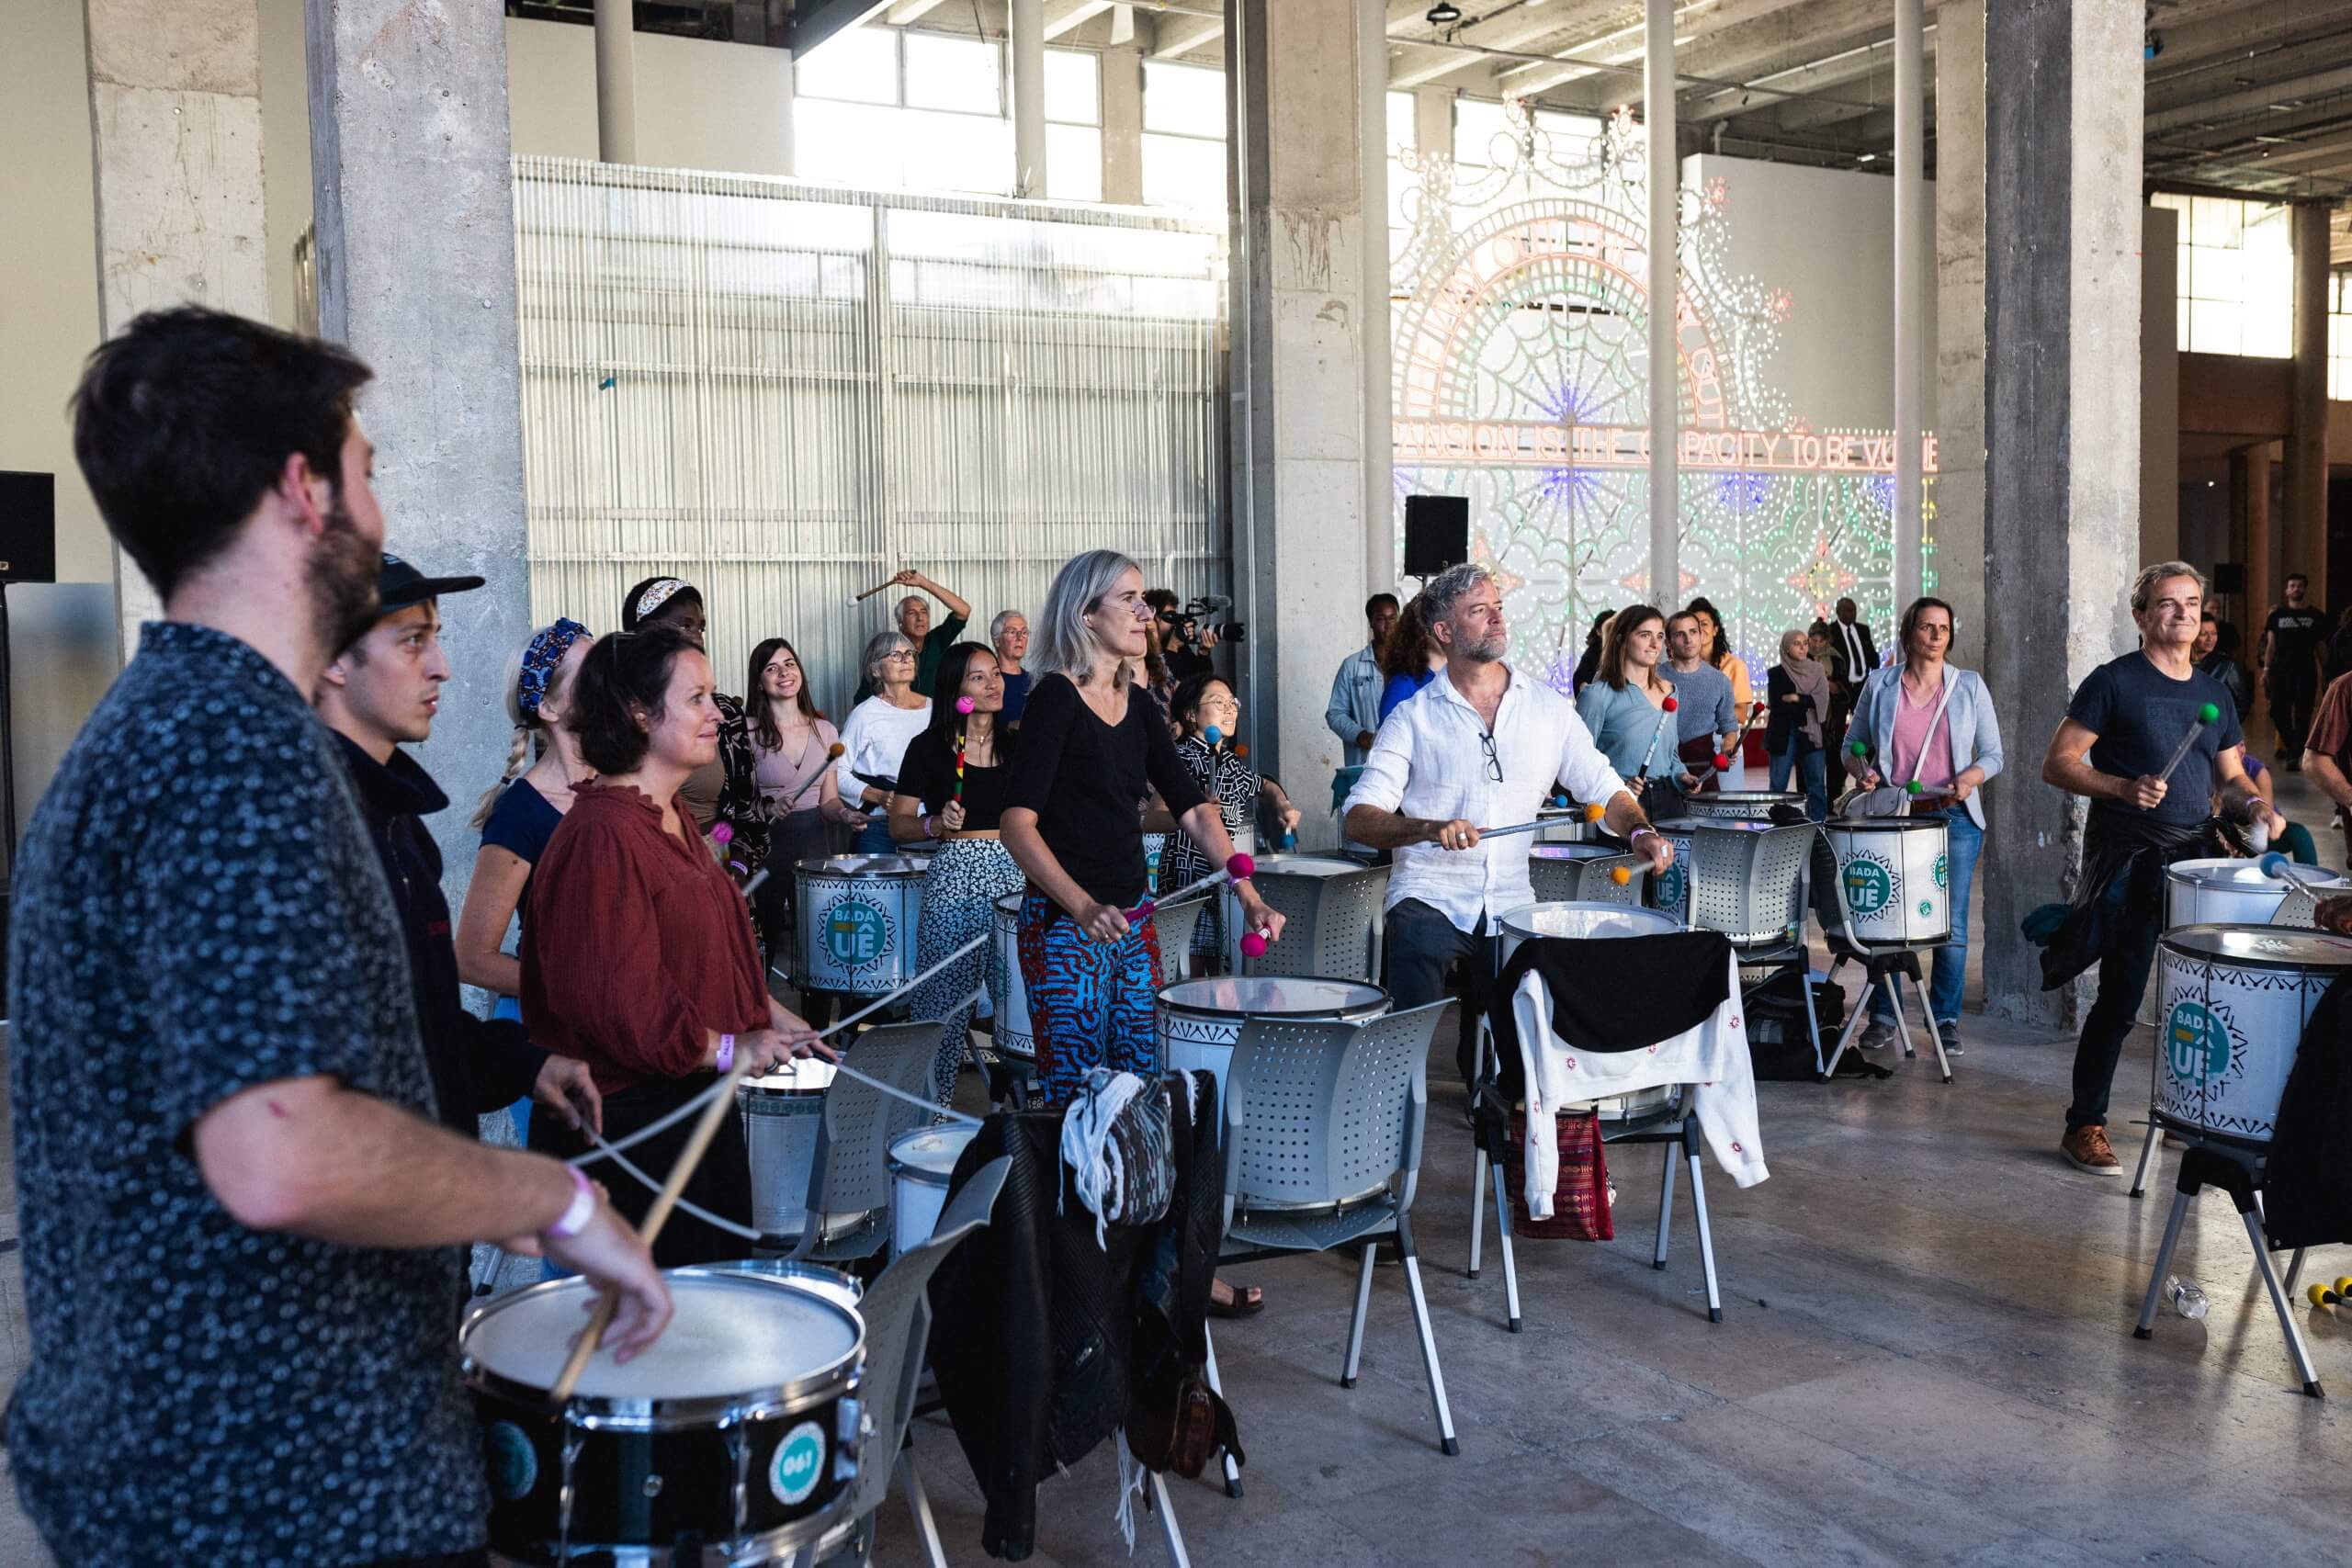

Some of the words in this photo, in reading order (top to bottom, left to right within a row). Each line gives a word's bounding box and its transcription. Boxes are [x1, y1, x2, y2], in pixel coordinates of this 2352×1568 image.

[1535, 425, 1559, 459] IS
[1572, 426, 1624, 462] THE
[1788, 434, 1820, 467] TO
[1826, 435, 1856, 468] BE
[1849, 866, 1881, 877] BADA
[1657, 874, 1675, 901] UÊ
[1849, 878, 1881, 908] UÊ
[834, 909, 876, 922] BADA
[834, 922, 876, 958] UÊ
[2177, 1010, 2215, 1033] BADA
[2175, 1034, 2215, 1081] UÊ
